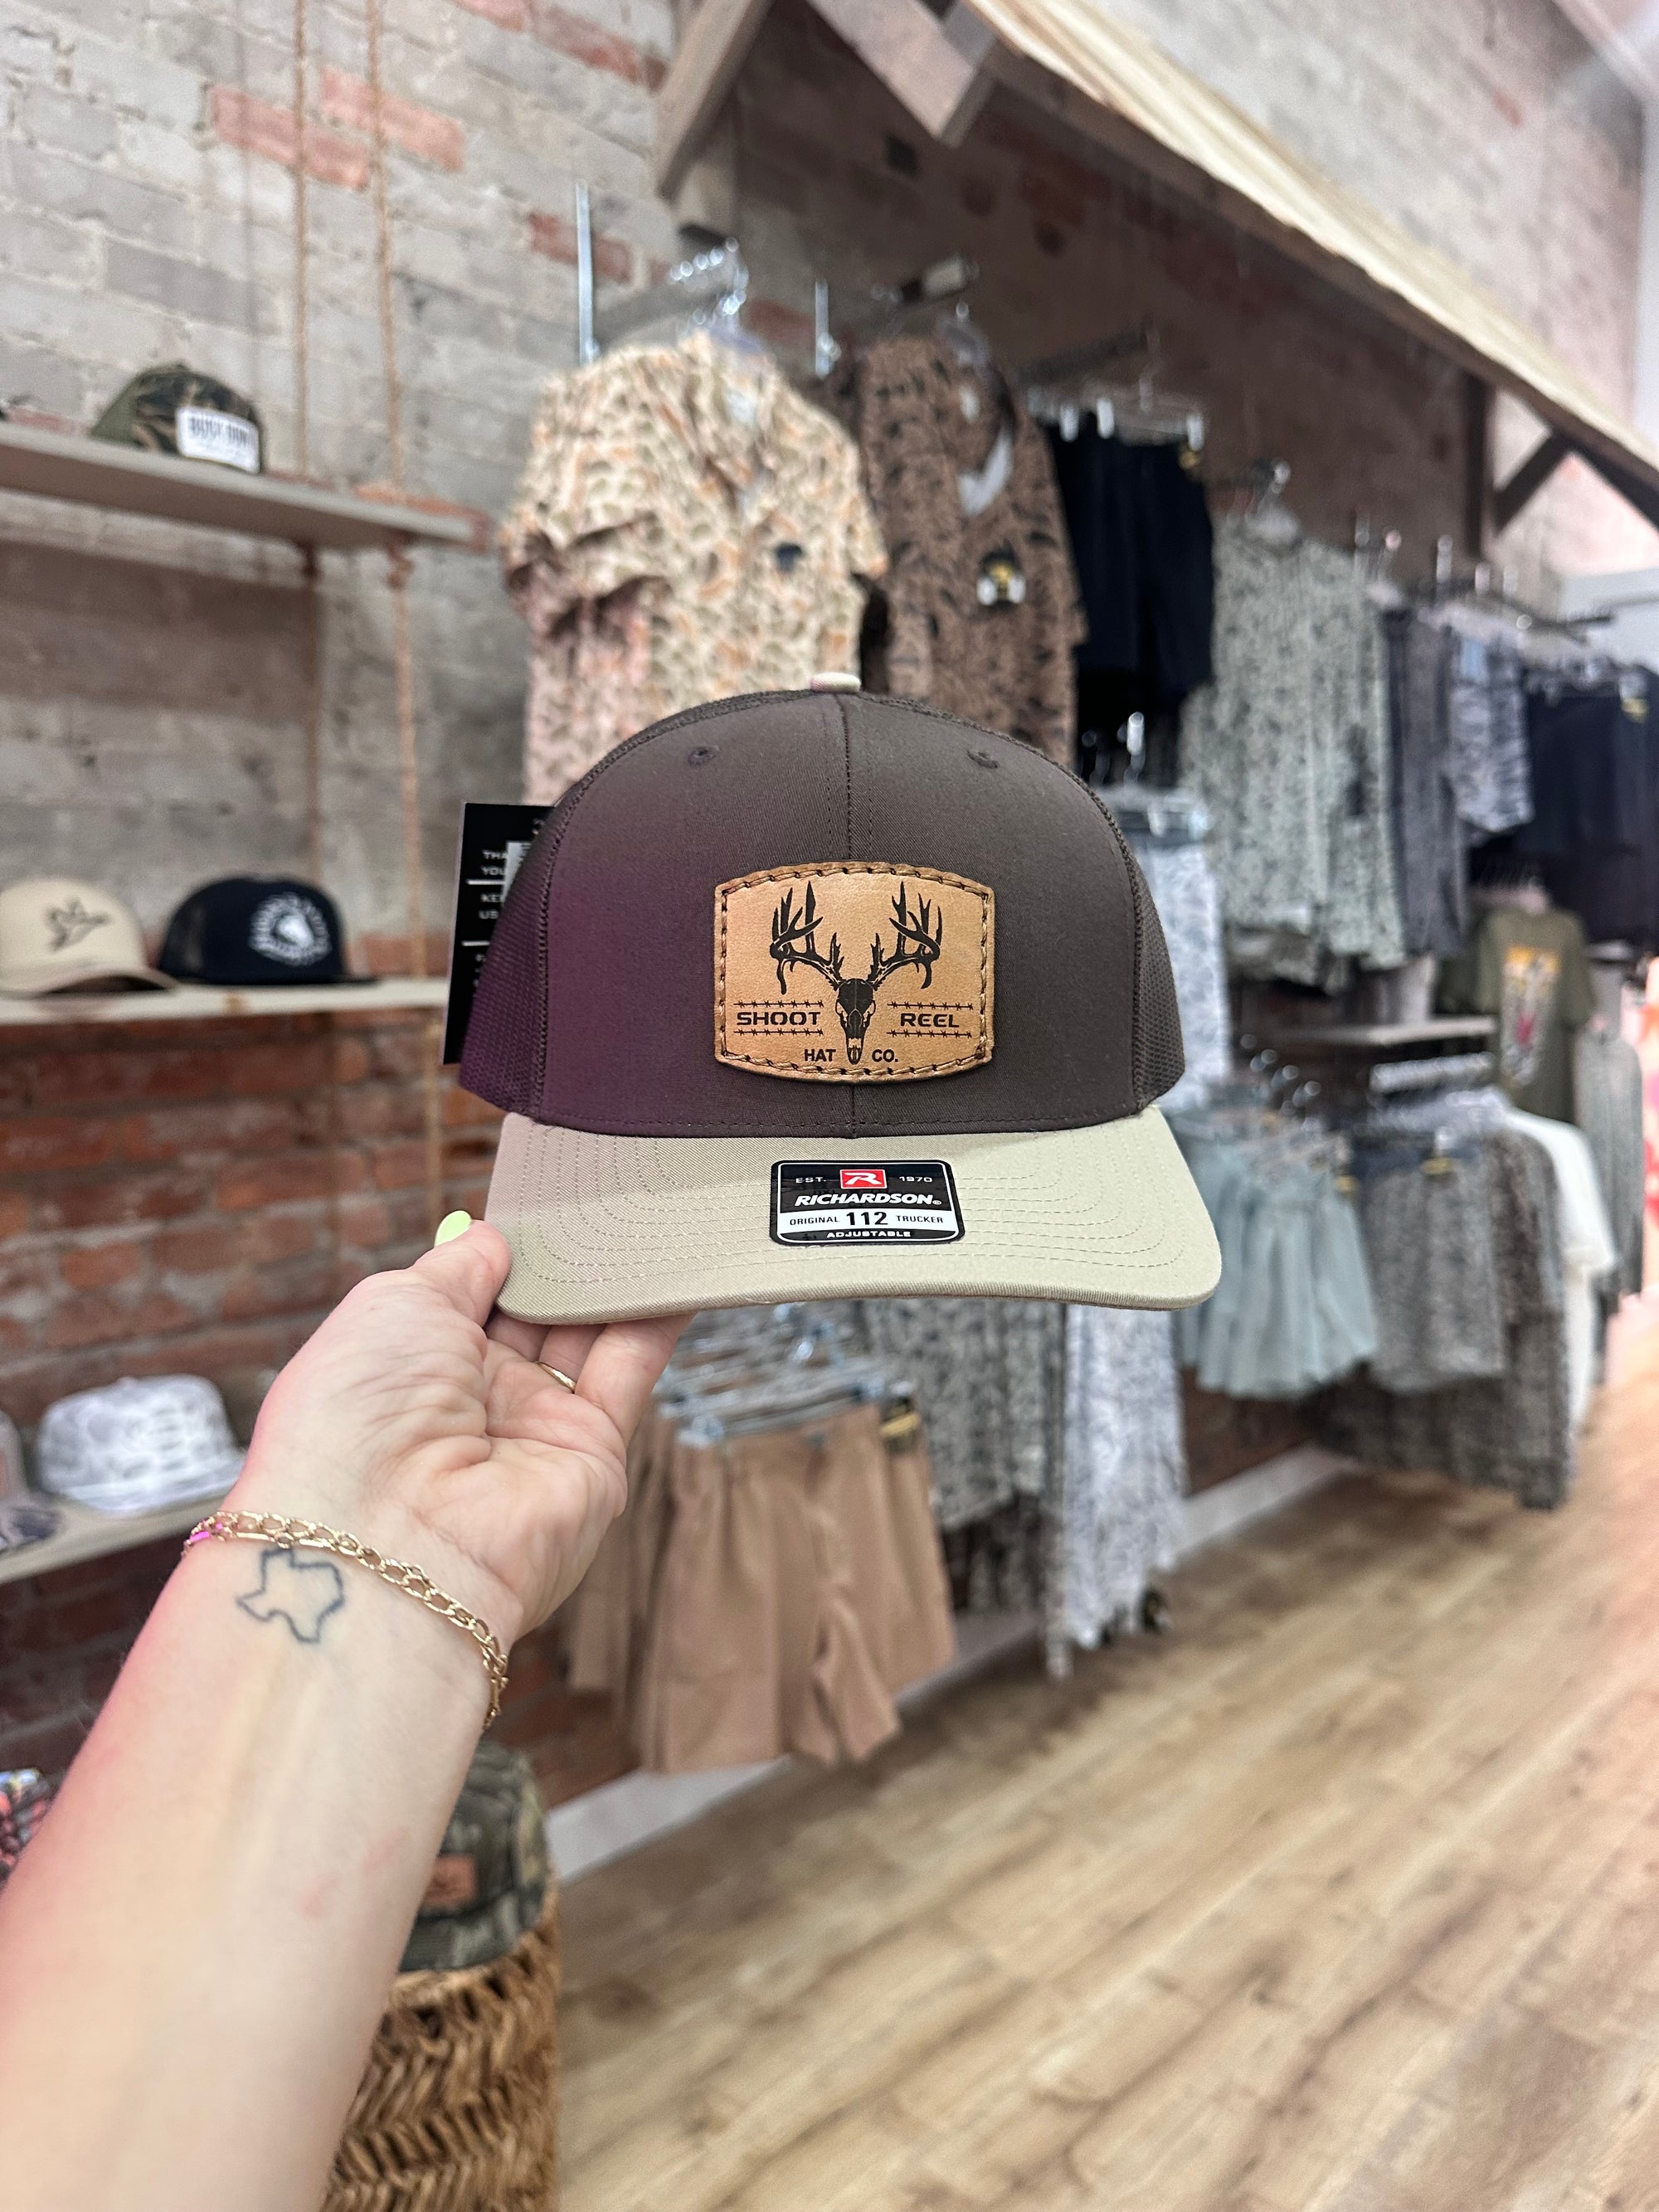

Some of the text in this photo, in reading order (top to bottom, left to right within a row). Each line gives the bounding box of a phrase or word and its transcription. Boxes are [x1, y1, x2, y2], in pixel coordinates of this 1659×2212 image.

[737, 1011, 960, 1028] SHOOT REEL
[804, 1048, 899, 1063] HAT CO.
[794, 1193, 934, 1207] RICHARDSON
[790, 1211, 944, 1226] ORIGINAL 112 TRUCKER
[826, 1230, 912, 1238] ADJUSTABLE
